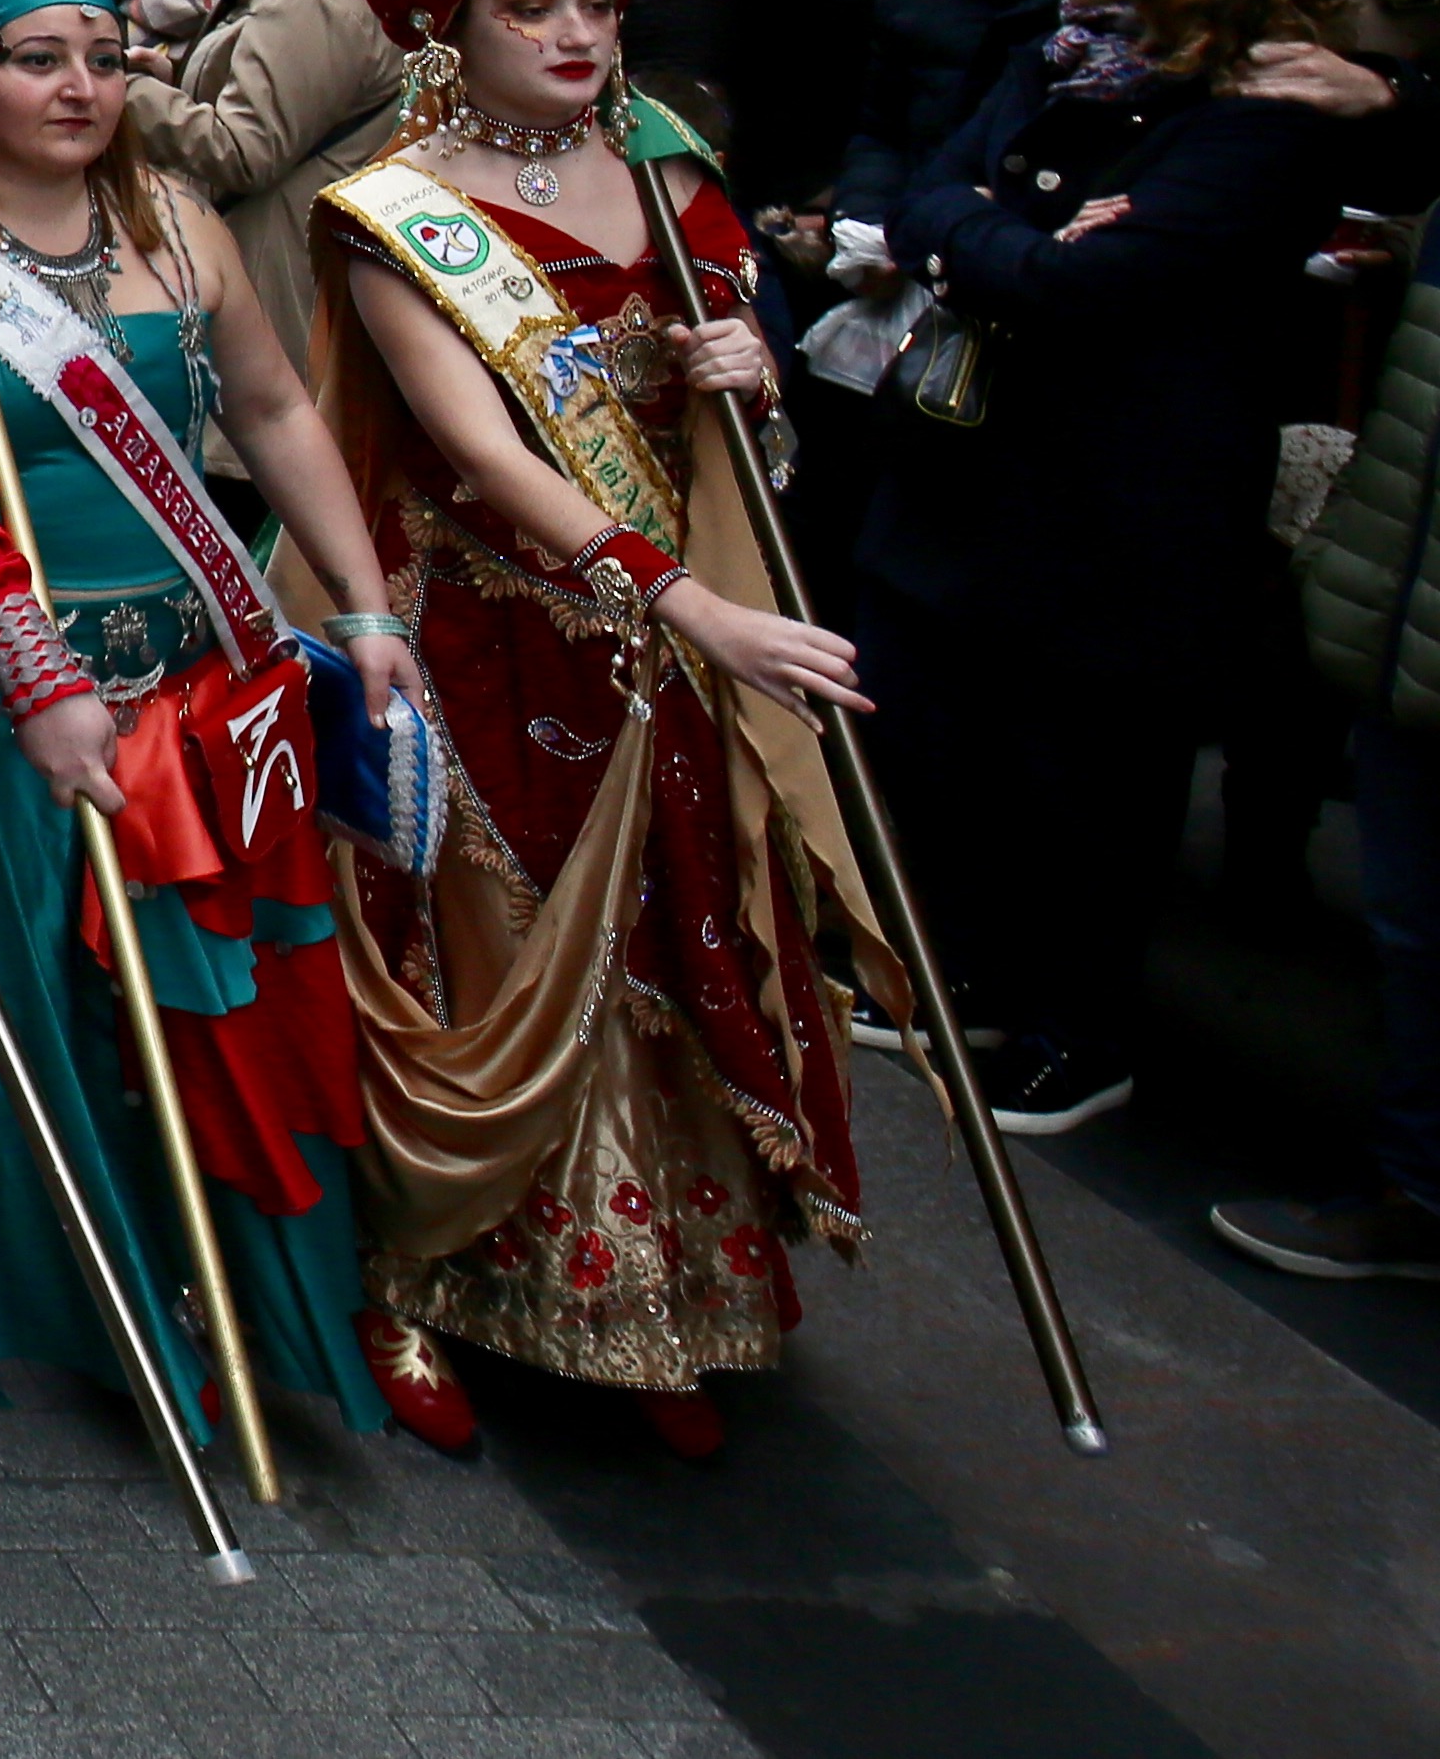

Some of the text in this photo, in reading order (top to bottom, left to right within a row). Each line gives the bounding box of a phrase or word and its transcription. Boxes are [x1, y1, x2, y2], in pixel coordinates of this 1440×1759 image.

[379, 184, 440, 217] LOS PACOS
[461, 265, 508, 297] ALTOZANO
